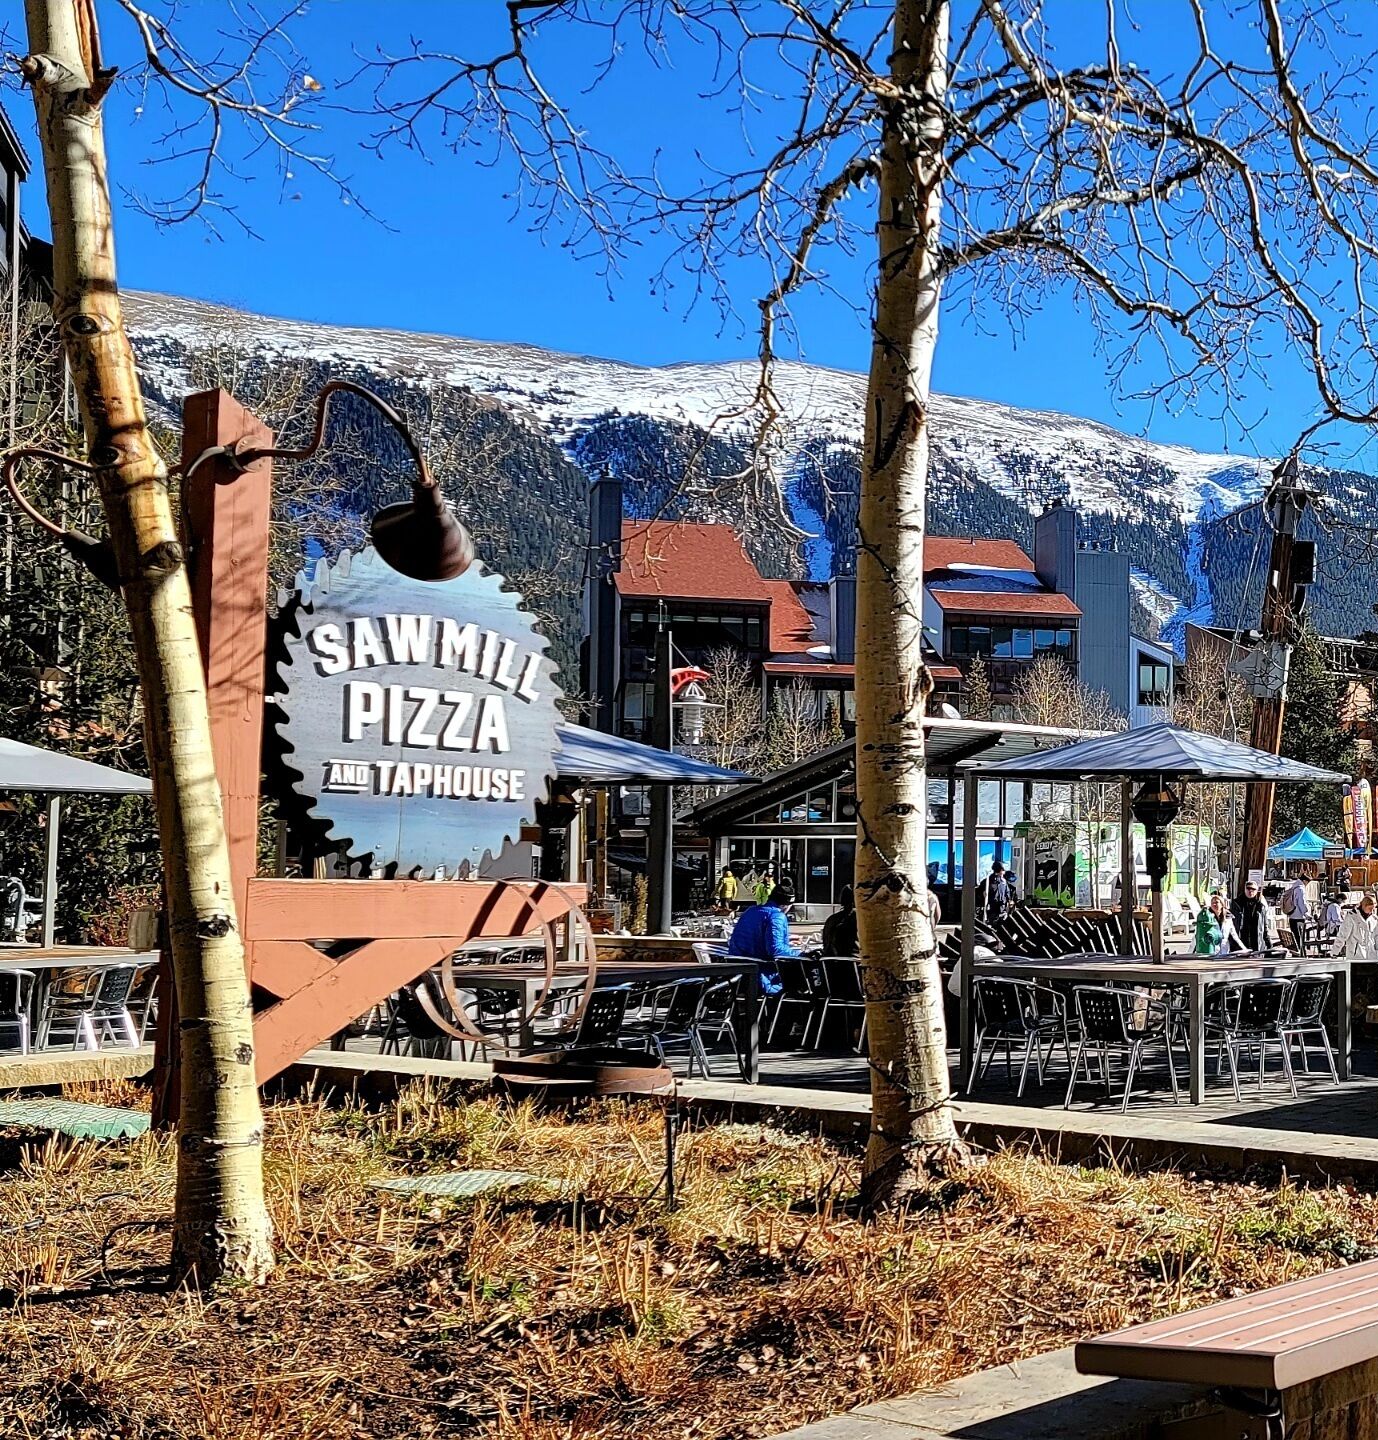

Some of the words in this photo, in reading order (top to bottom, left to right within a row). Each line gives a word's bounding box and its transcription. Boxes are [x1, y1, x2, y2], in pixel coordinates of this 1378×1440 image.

[308, 613, 545, 702] SAWMILL
[346, 679, 511, 752] PIZZA
[328, 762, 370, 787] AND
[374, 759, 527, 801] TAPHOUSE
